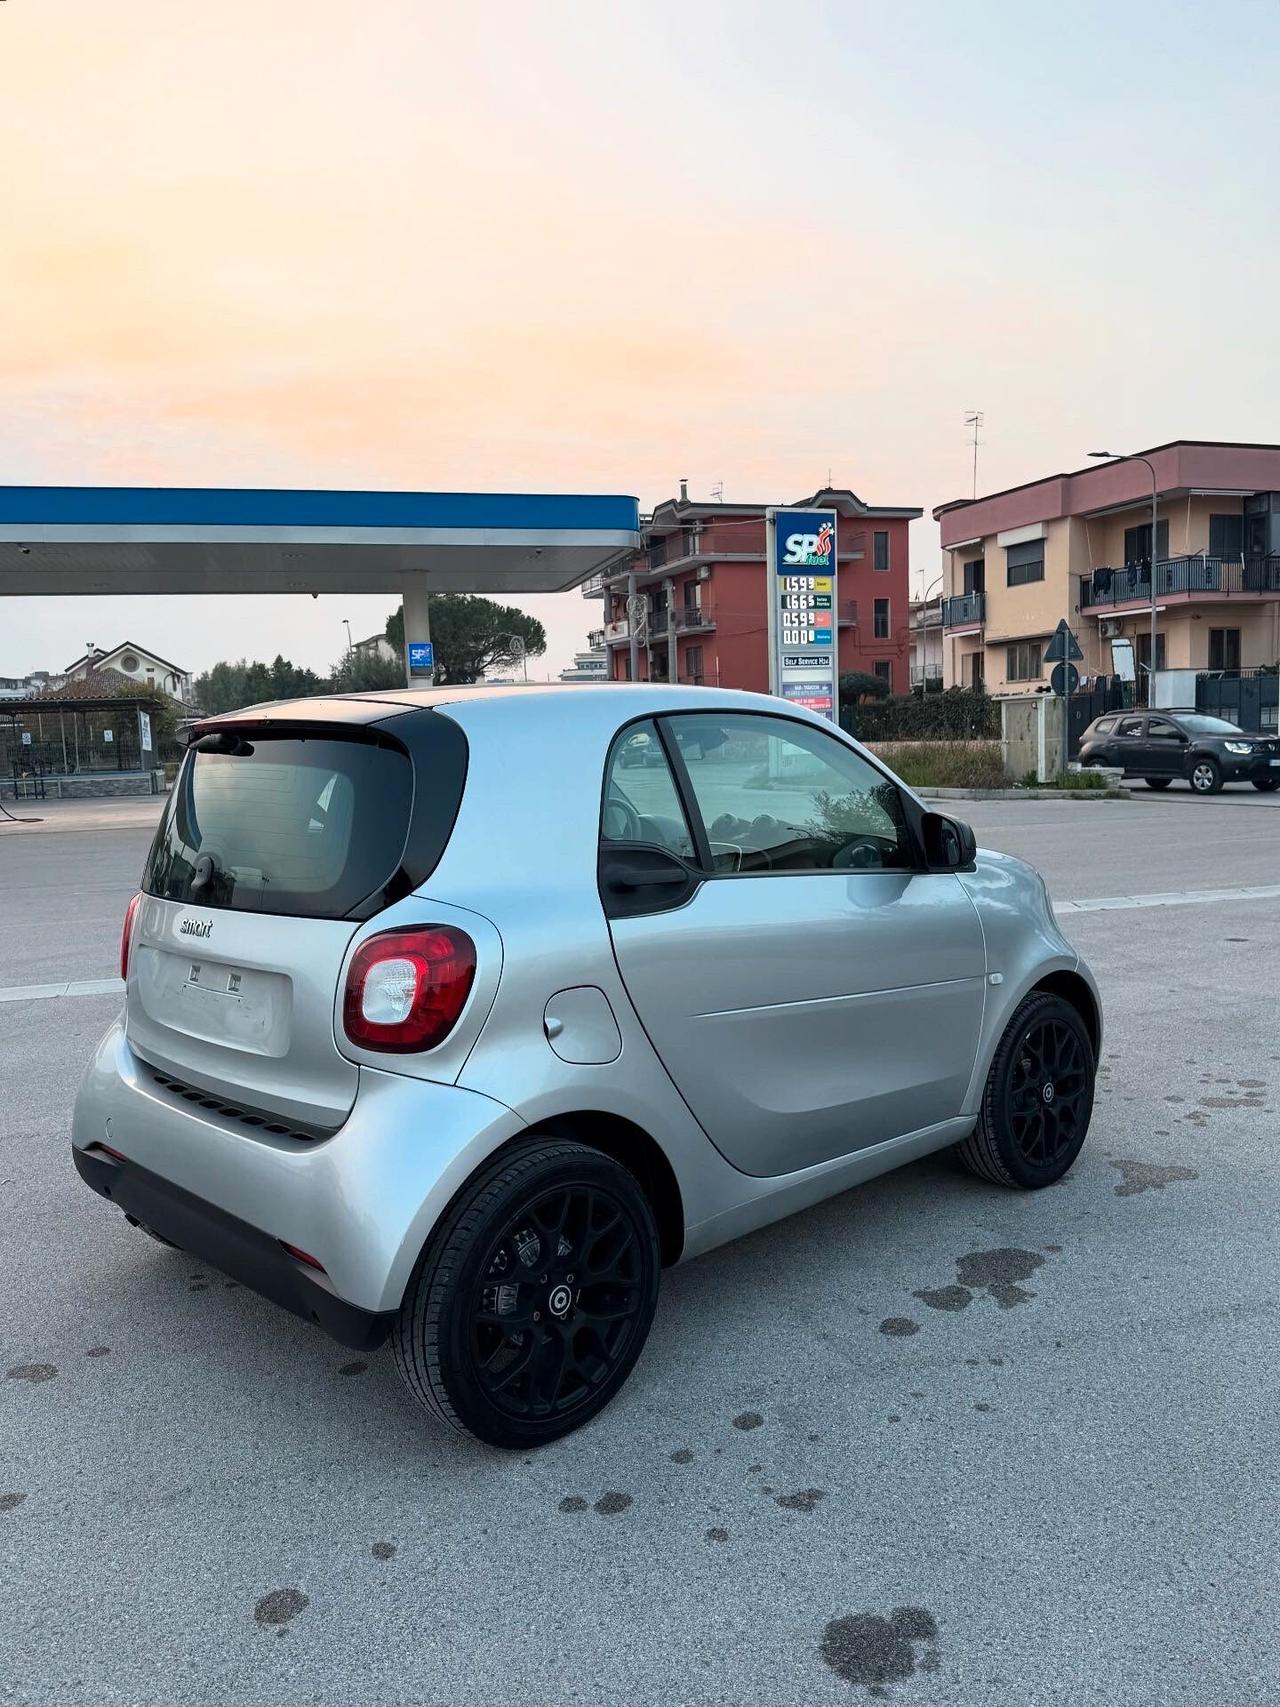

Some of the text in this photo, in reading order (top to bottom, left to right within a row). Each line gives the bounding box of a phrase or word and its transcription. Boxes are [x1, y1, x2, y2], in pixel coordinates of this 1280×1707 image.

[783, 533, 818, 563] SP
[806, 553, 830, 566] fuel
[179, 919, 213, 938] smart
